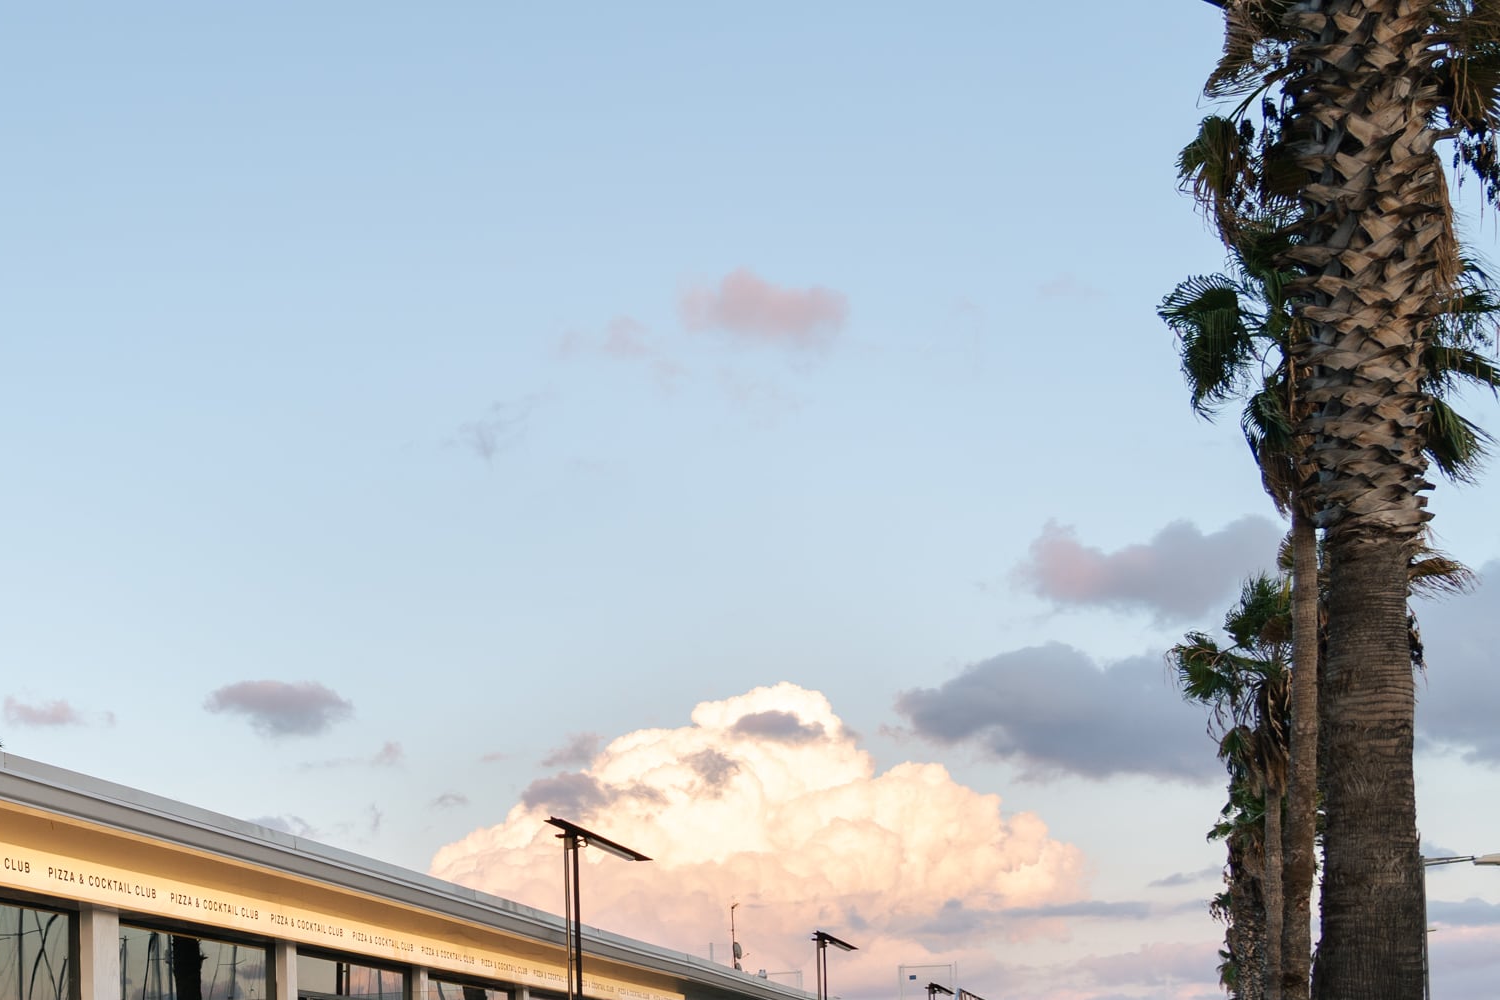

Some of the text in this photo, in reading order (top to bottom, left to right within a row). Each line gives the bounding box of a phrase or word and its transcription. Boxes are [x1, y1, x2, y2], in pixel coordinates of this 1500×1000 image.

[4, 857, 30, 873] CLUB
[48, 867, 156, 899] PIZZA & COCKTAIL CLUB
[171, 892, 192, 906] PIZZA
[203, 899, 238, 916] COCKTAIL
[241, 907, 259, 920] CLUB
[270, 913, 288, 926] PIZZA
[297, 919, 326, 934] COCKTAIL
[329, 926, 343, 937] CLUB
